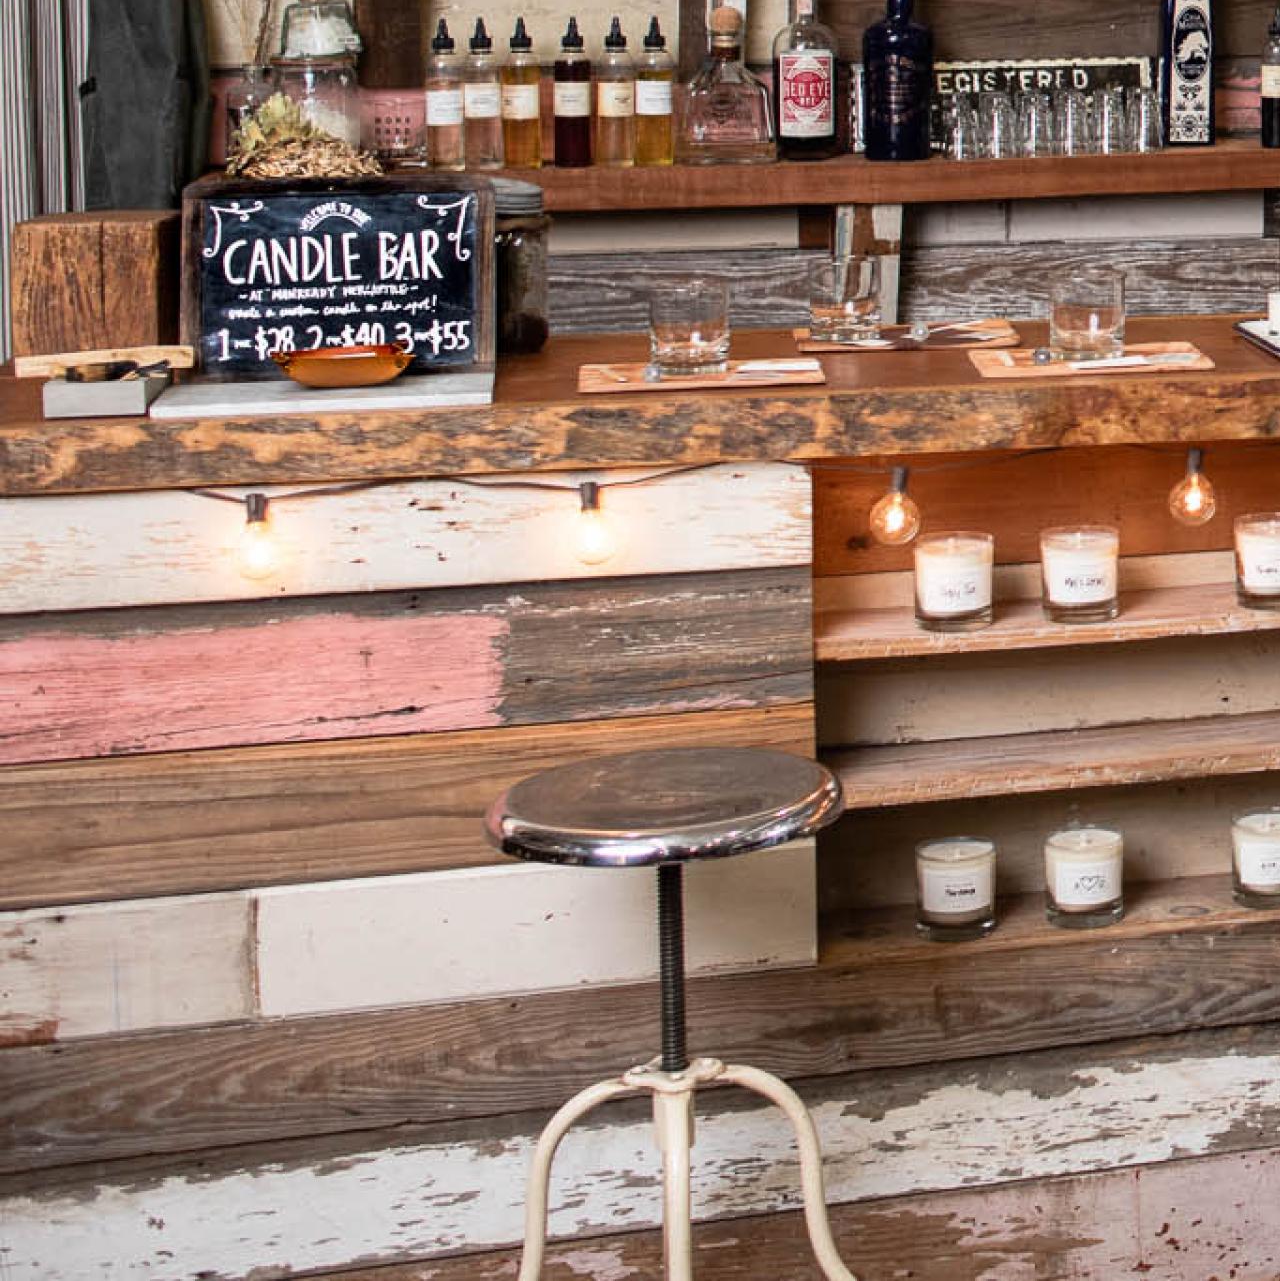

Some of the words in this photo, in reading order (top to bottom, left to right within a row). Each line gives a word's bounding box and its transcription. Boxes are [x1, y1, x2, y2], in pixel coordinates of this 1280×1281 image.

[936, 68, 1089, 94] EGISTERED
[223, 232, 362, 286] CANDLE
[378, 229, 445, 281] BAR
